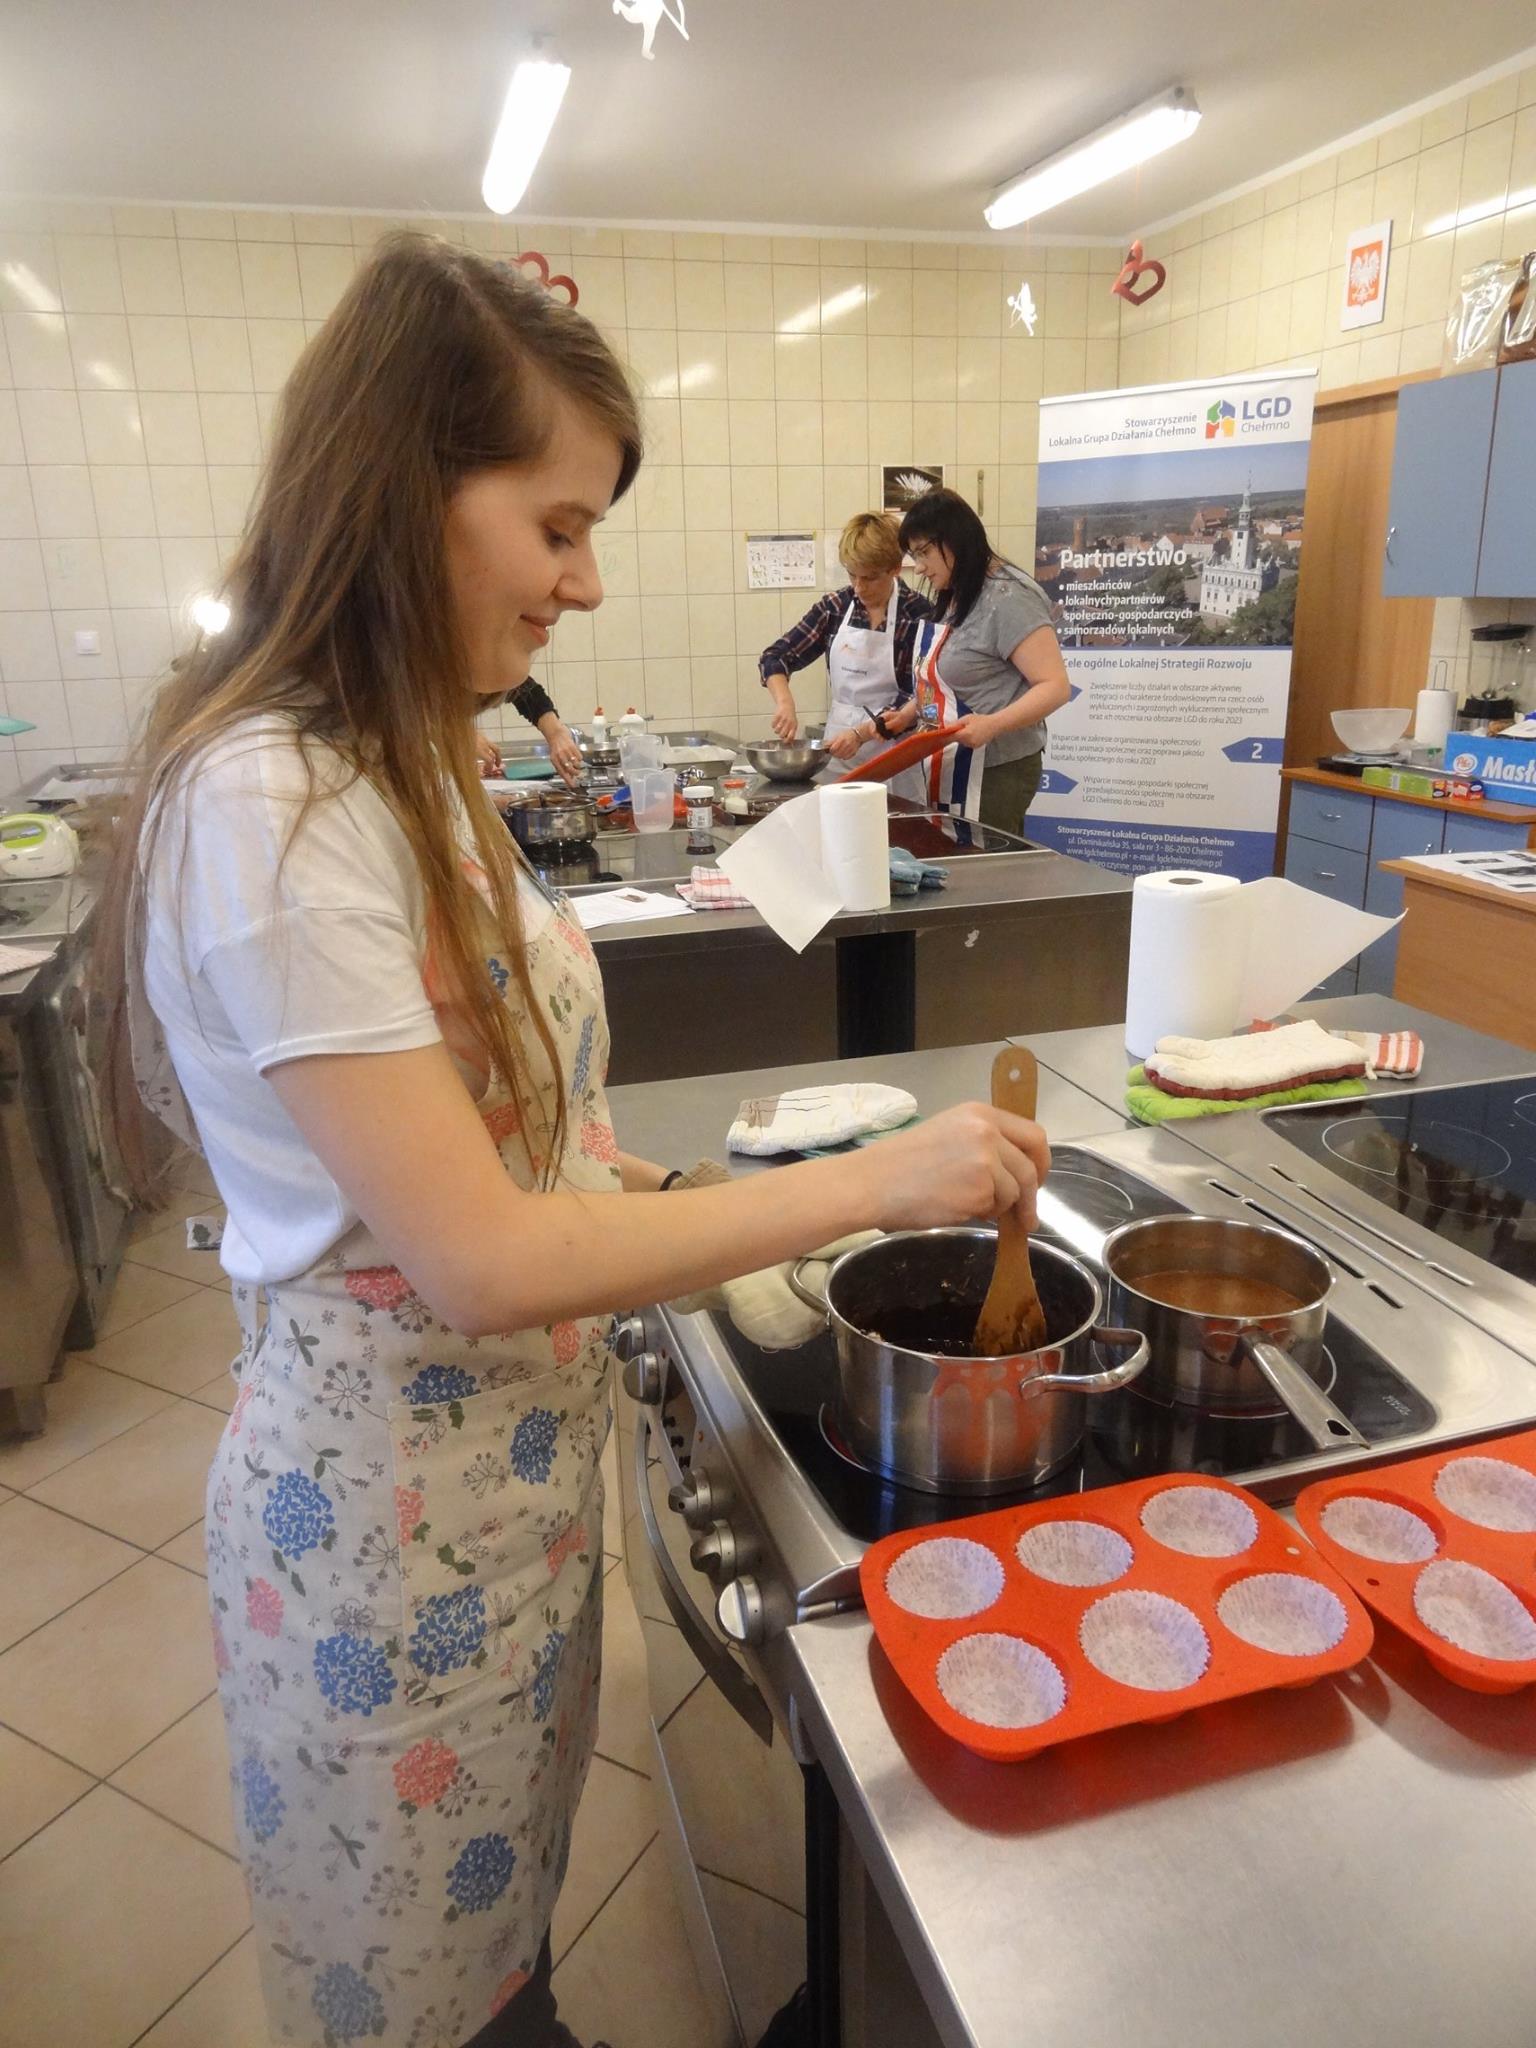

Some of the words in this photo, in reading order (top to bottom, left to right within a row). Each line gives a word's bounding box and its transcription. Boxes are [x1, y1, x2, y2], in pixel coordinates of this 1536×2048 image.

[1242, 397, 1292, 420] LGD
[1124, 413, 1198, 428] Stowarzyszenie
[1241, 421, 1290, 433] Chełmno
[1049, 437, 1082, 447] Lokalna
[1084, 434, 1109, 445] Grupa
[1111, 430, 1153, 441] Działania
[1155, 426, 1196, 437] Chełmno
[1060, 547, 1187, 569] Partnerstwo
[1066, 579, 1131, 591] mieszkańców
[1065, 595, 1112, 607] lokalnych
[1112, 593, 1165, 606] partnerów
[1064, 608, 1192, 622] społeczno-gospodarczych
[1064, 624, 1126, 636] samorządów
[1127, 624, 1174, 636] lokalnych
[1083, 658, 1117, 670] ogólne
[1119, 658, 1158, 670] Lokalnej
[1160, 658, 1204, 670] Strategii
[1207, 658, 1252, 670] Rozwoju
[1180, 684, 1209, 692] obszarze
[1184, 715, 1199, 723] LGD
[1225, 716, 1243, 724] 2023
[1251, 742, 1263, 760] 2
[1481, 756, 1536, 784] Mast
[1042, 774, 1050, 789] 3
[1056, 825, 1112, 837] Stowarzyszenie
[1112, 829, 1140, 839] Lokalna
[1140, 832, 1163, 843] Grupa
[1164, 833, 1199, 844] Działania
[1200, 836, 1235, 847] Chełmno
